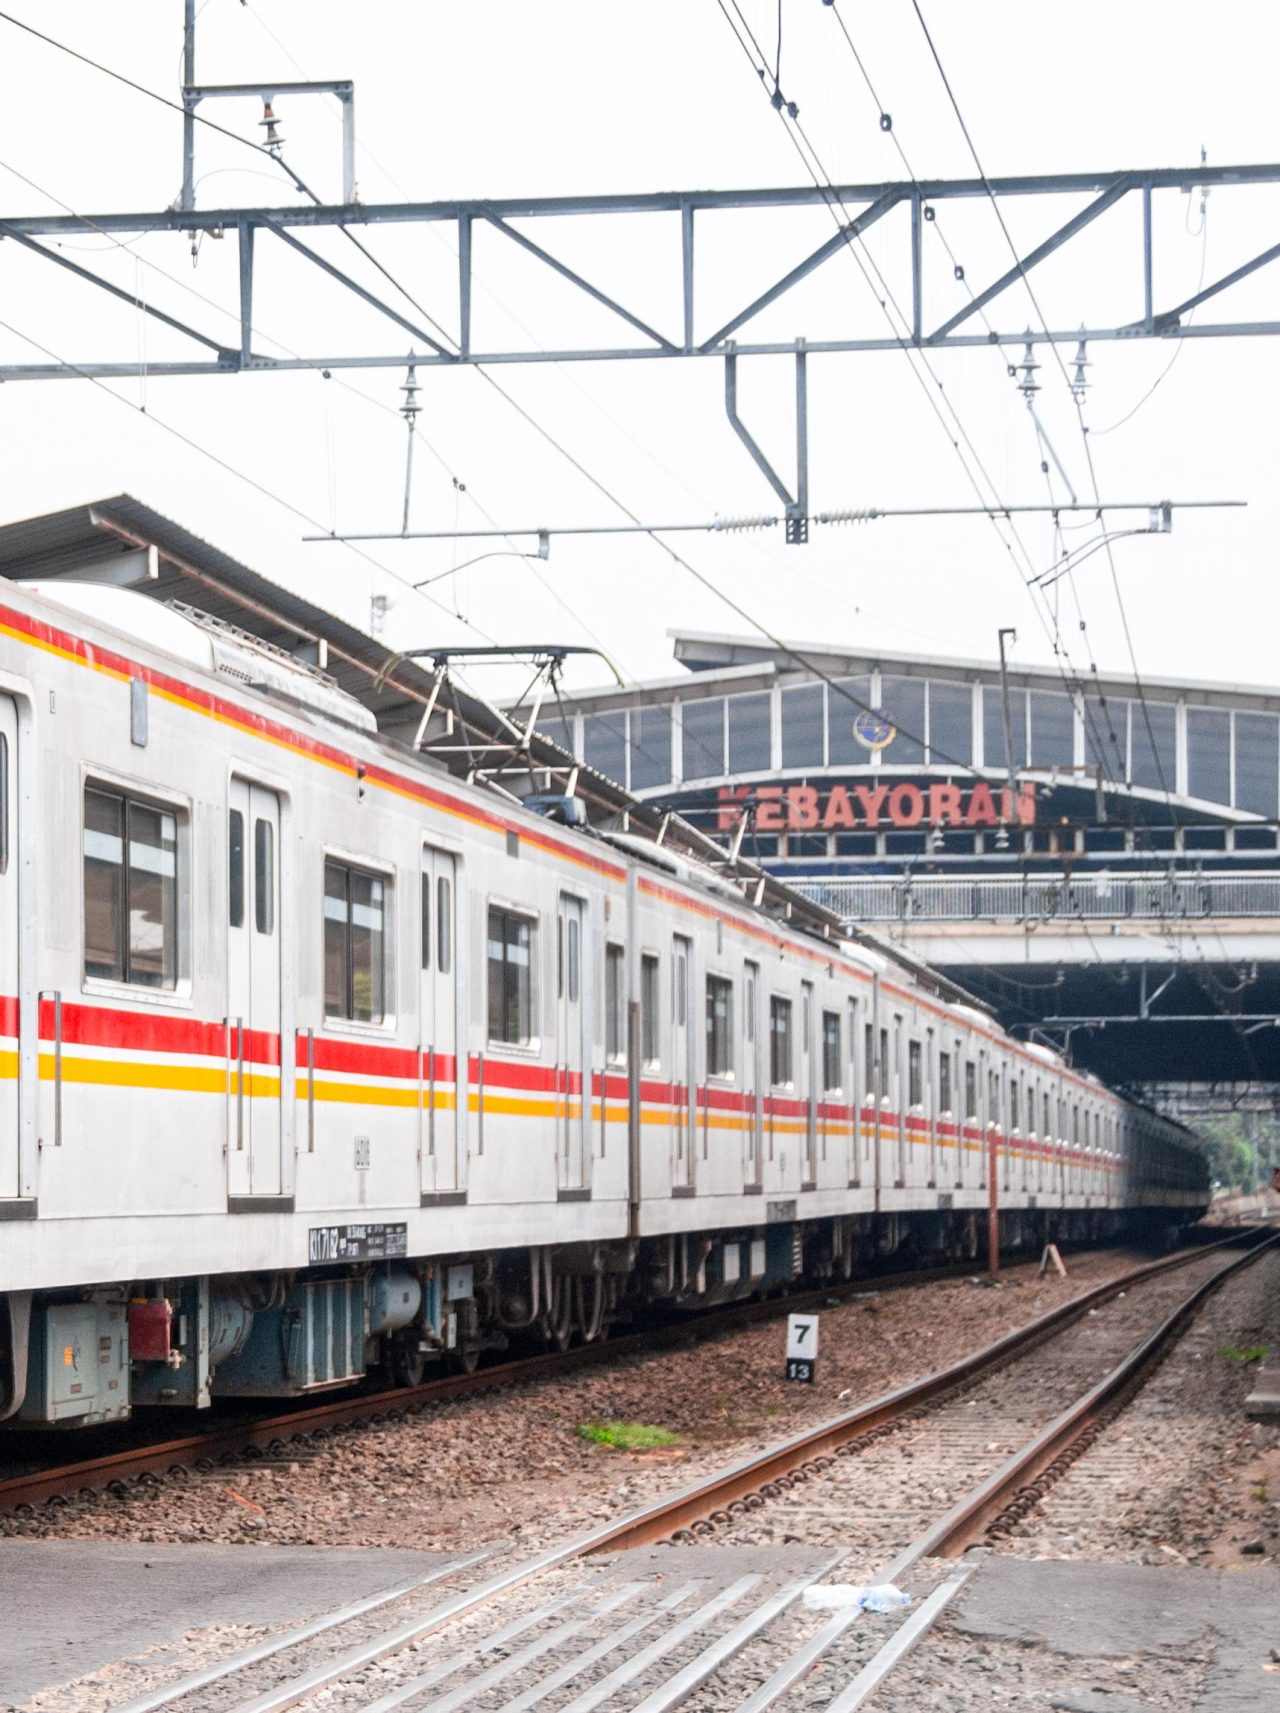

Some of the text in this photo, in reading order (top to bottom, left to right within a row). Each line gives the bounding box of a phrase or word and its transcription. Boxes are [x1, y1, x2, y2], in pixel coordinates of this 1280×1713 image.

[717, 782, 1036, 830] KEBAYORAN
[794, 1324, 811, 1344] 7
[790, 1363, 810, 1379] 13
